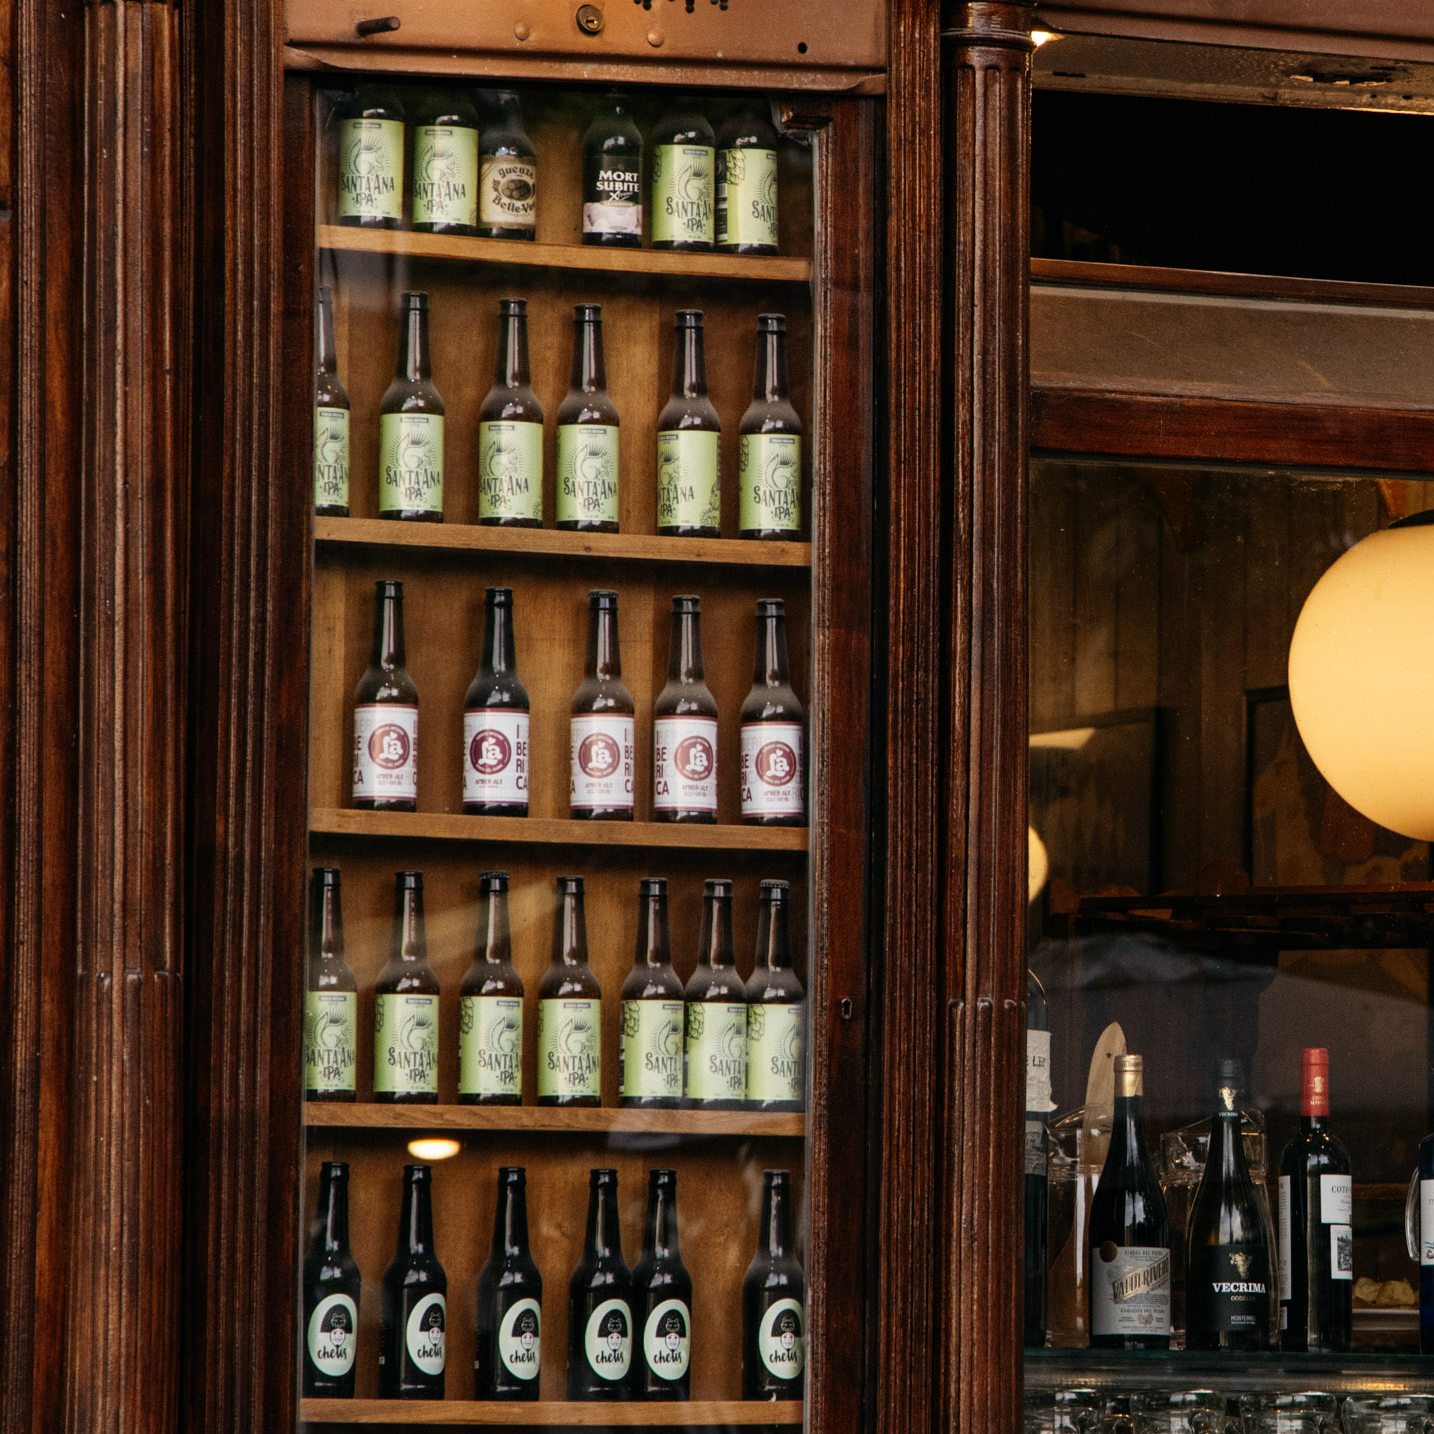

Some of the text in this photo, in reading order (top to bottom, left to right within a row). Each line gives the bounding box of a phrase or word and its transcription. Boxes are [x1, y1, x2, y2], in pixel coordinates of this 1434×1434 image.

[598, 170, 638, 182] MORT
[596, 181, 639, 193] SUBITE
[1212, 1282, 1266, 1293] VECRIMA
